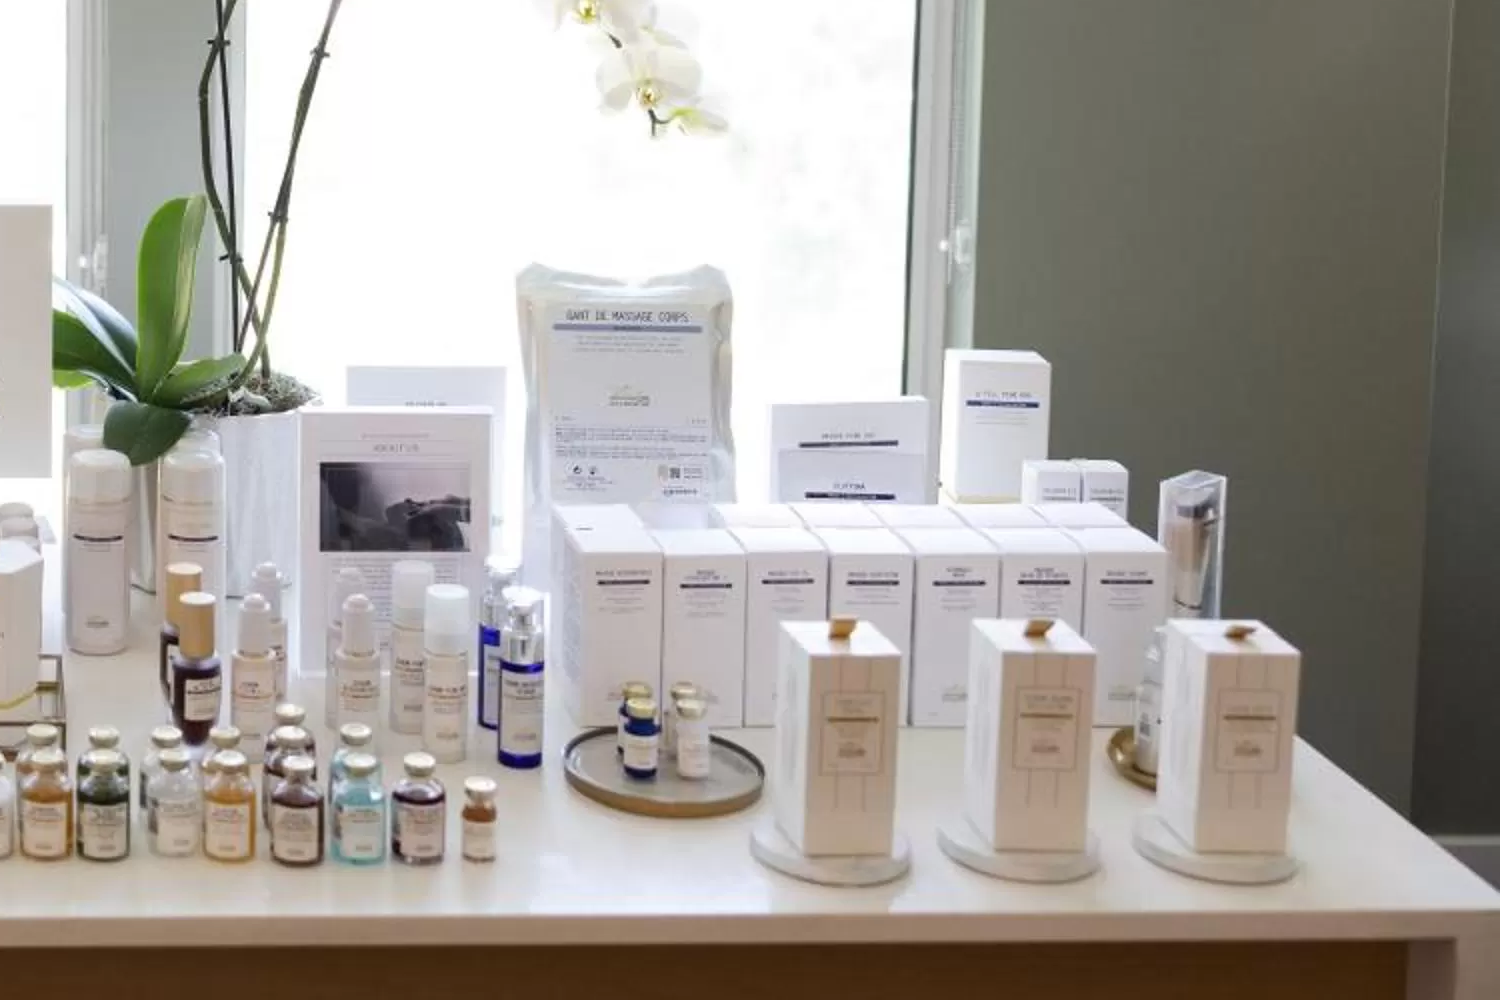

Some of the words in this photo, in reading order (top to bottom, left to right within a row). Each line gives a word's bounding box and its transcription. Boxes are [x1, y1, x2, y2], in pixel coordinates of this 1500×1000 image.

[565, 308, 589, 322] GANT
[611, 310, 653, 323] MASSAGE
[658, 311, 690, 323] CORPS
